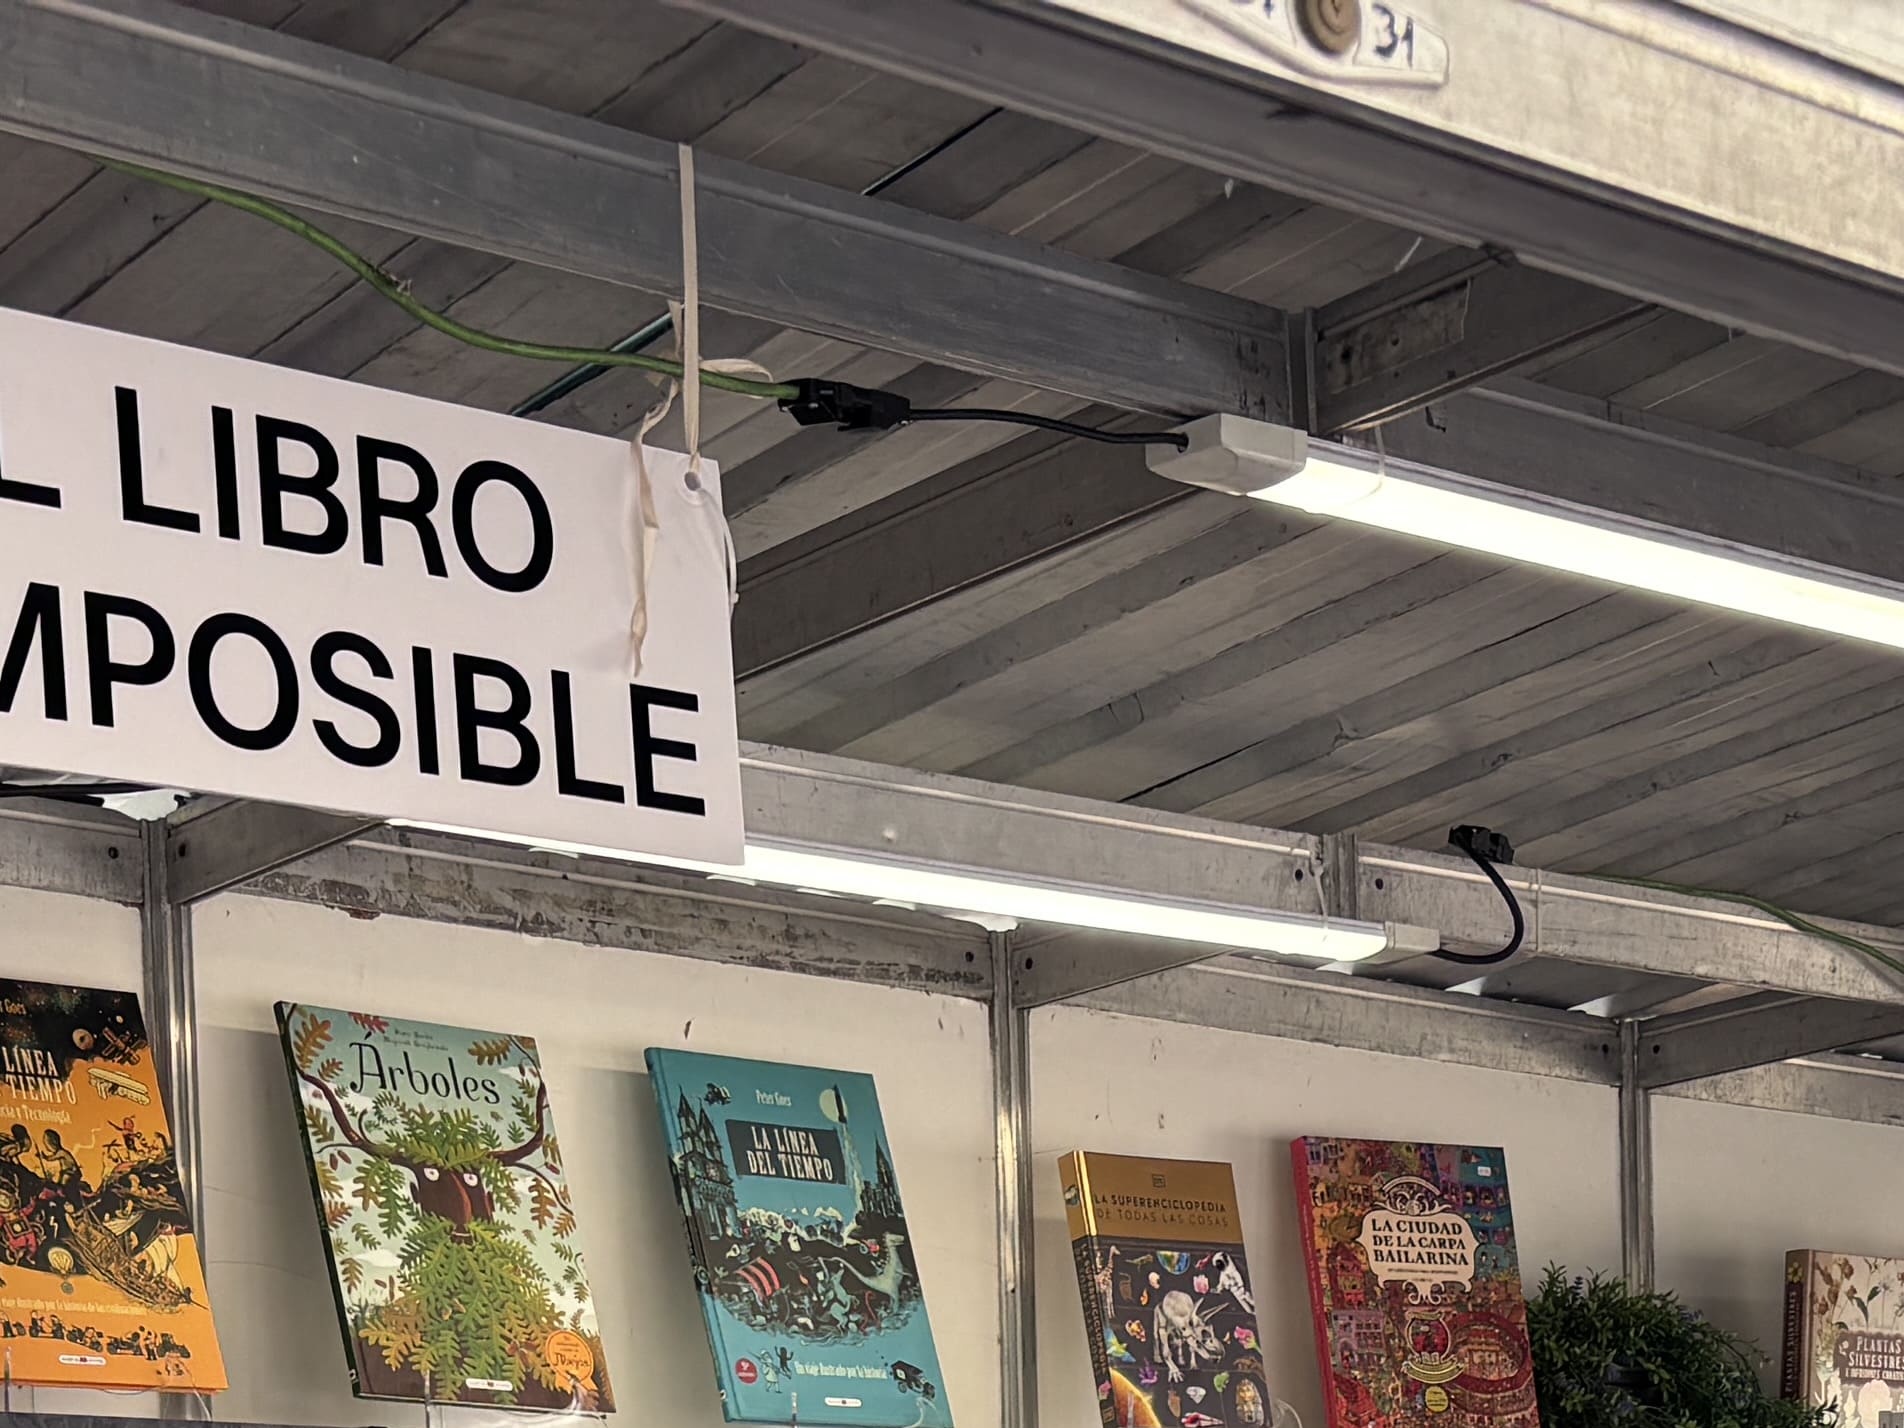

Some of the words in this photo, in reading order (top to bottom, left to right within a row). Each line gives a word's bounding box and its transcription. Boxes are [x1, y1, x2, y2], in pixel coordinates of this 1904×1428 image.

[1372, 14, 1416, 59] 31
[114, 386, 555, 592] LIBRO
[349, 1036, 501, 1104] Árboles
[751, 1125, 770, 1151] LA
[775, 1126, 818, 1159] LÍNEA
[747, 1150, 775, 1175] DEL
[779, 1154, 834, 1182] TIEMPO
[1371, 1218, 1392, 1234] LA
[1396, 1220, 1462, 1235] CIUDAD
[1373, 1235, 1393, 1246] DE
[1396, 1235, 1416, 1248] LA
[1419, 1236, 1467, 1251] CARPA
[1374, 1248, 1468, 1266] BAILARINA
[1857, 1337, 1901, 1353] PLANTAS
